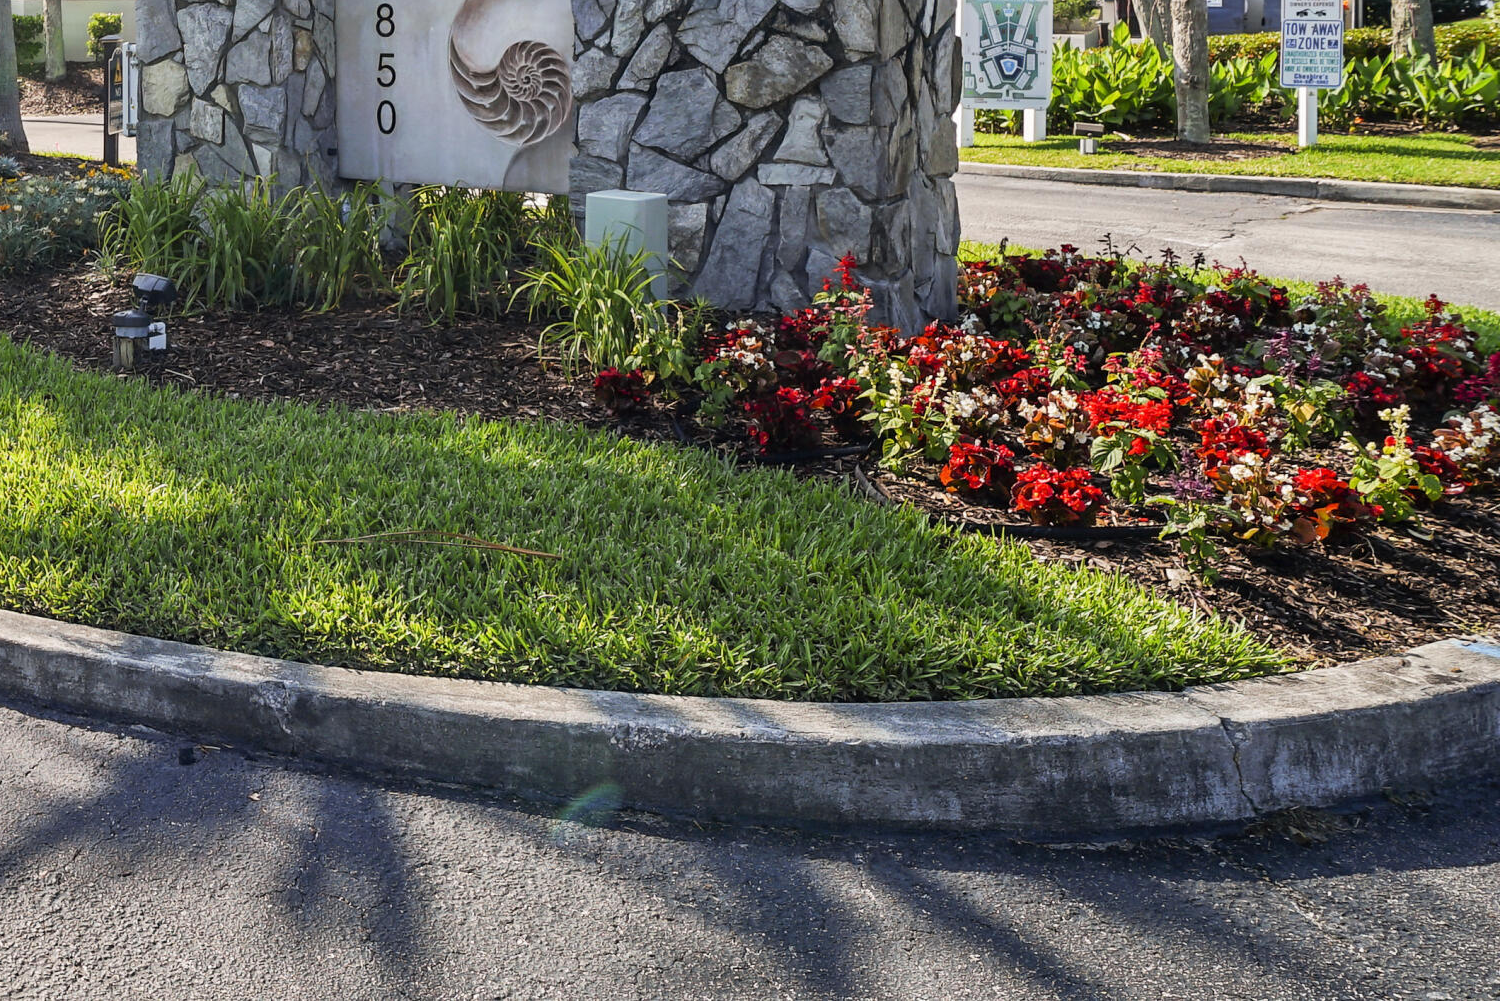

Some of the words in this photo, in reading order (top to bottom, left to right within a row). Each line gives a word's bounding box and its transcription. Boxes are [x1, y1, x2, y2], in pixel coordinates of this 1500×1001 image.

[1285, 22, 1307, 36] TOW
[1312, 23, 1340, 36] AWAY
[1298, 37, 1326, 50] ZONE
[375, 2, 397, 135] 850
